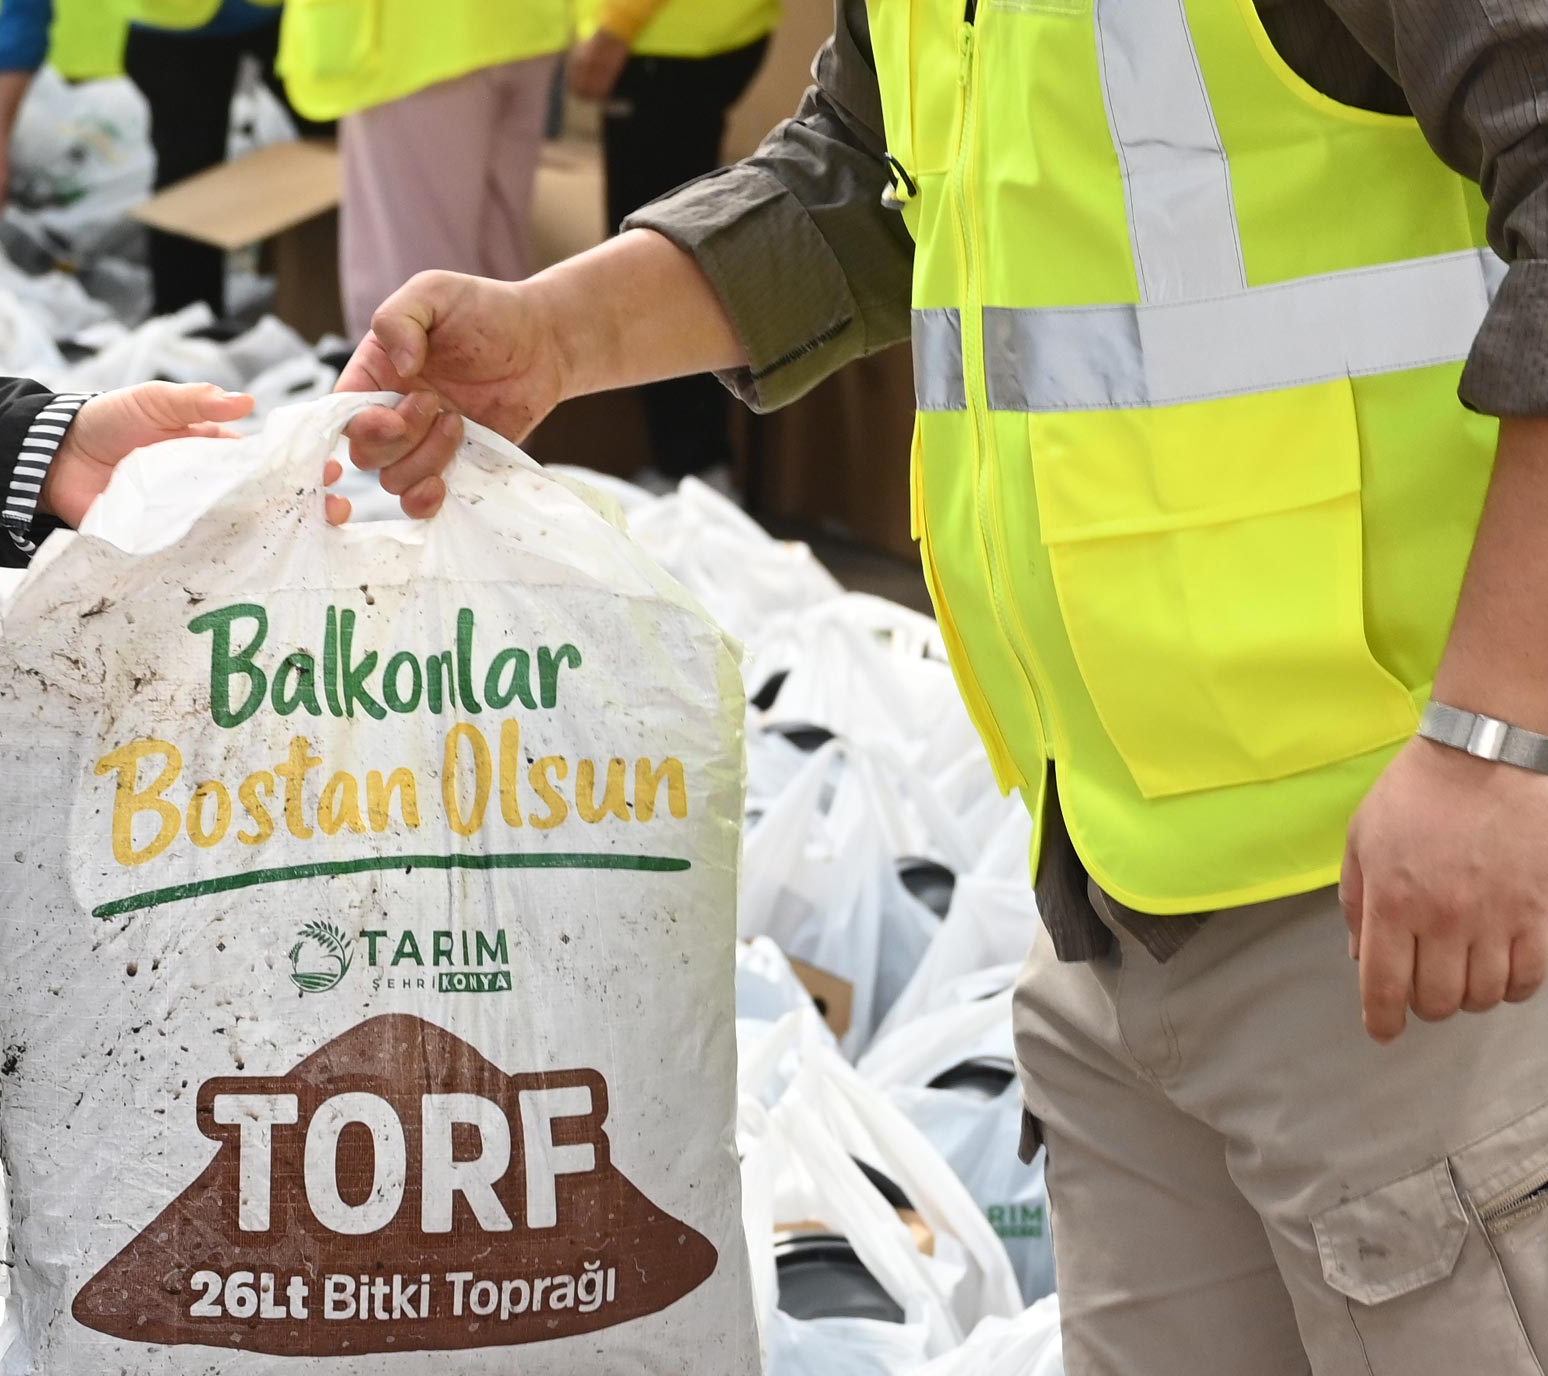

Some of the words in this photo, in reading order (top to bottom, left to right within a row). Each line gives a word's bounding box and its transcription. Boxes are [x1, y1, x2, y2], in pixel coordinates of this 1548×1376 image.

[187, 601, 582, 730] Balkonlar
[92, 735, 419, 867] Bostan
[441, 718, 688, 839] Olsun
[358, 928, 510, 967] TARIM
[371, 975, 437, 992] ŞEHRİ
[441, 971, 510, 991] KONYA
[212, 1086, 597, 1234] TORF
[988, 1205, 1043, 1224] RIM
[189, 1269, 309, 1322] 26Lt
[323, 1271, 431, 1322] Bitki
[444, 1259, 617, 1327] Toprağı
